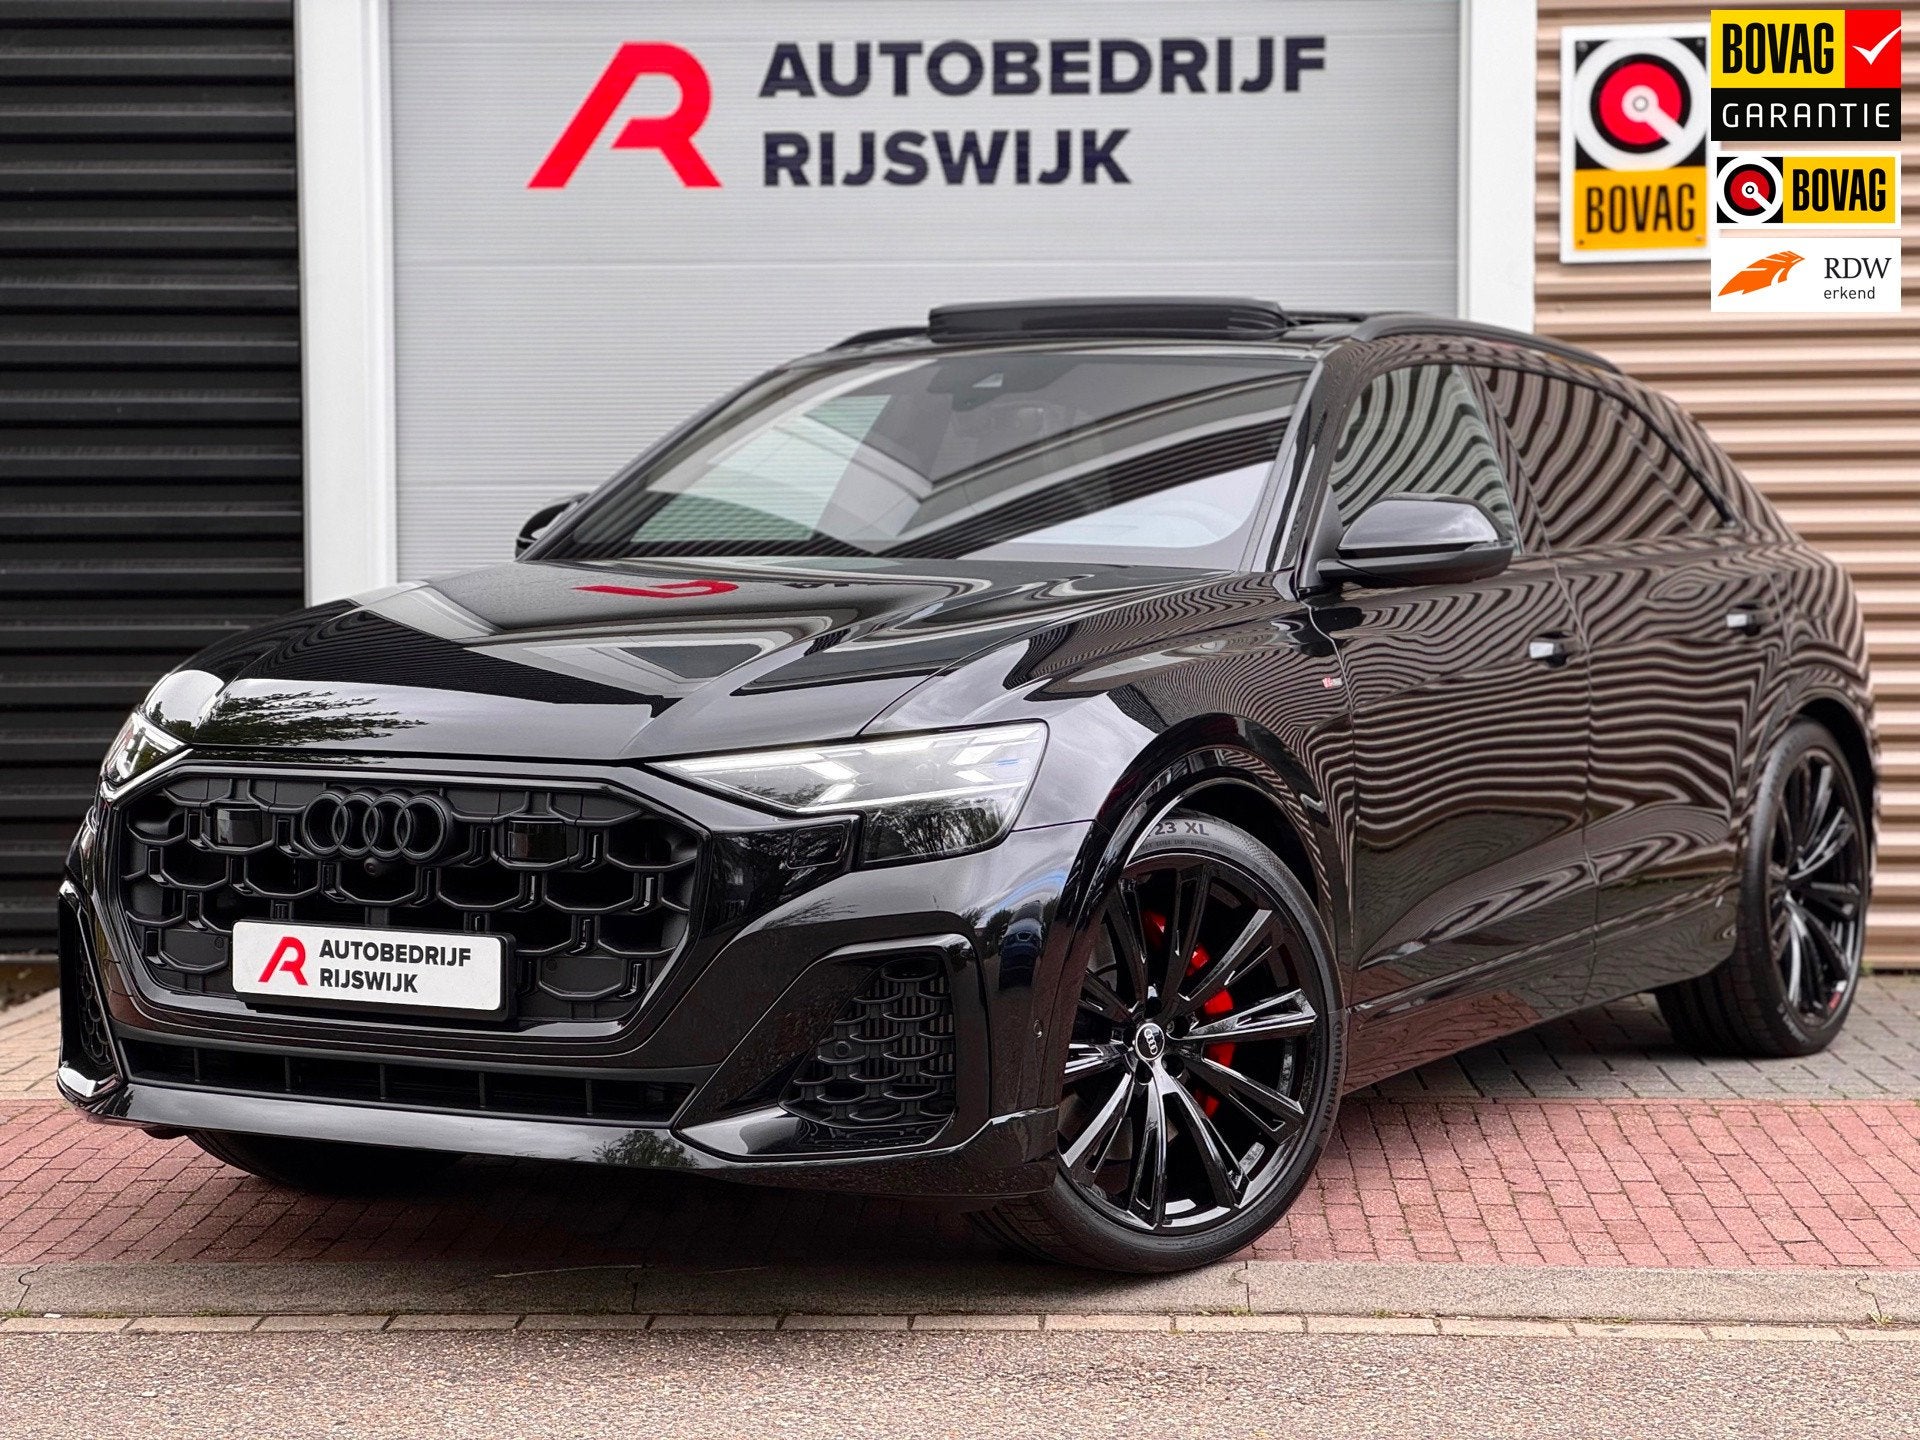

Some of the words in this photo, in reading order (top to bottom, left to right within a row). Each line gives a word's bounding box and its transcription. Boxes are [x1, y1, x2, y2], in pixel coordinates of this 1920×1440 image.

[759, 36, 1325, 98] AUTOBEDRIJF
[763, 129, 1131, 187] RIJSWIJK
[1586, 183, 1695, 234] BOVAG
[1184, 821, 1210, 837] XL
[319, 938, 471, 967] AUTOBEDRIJF
[319, 967, 419, 993] RIJSWIJK
